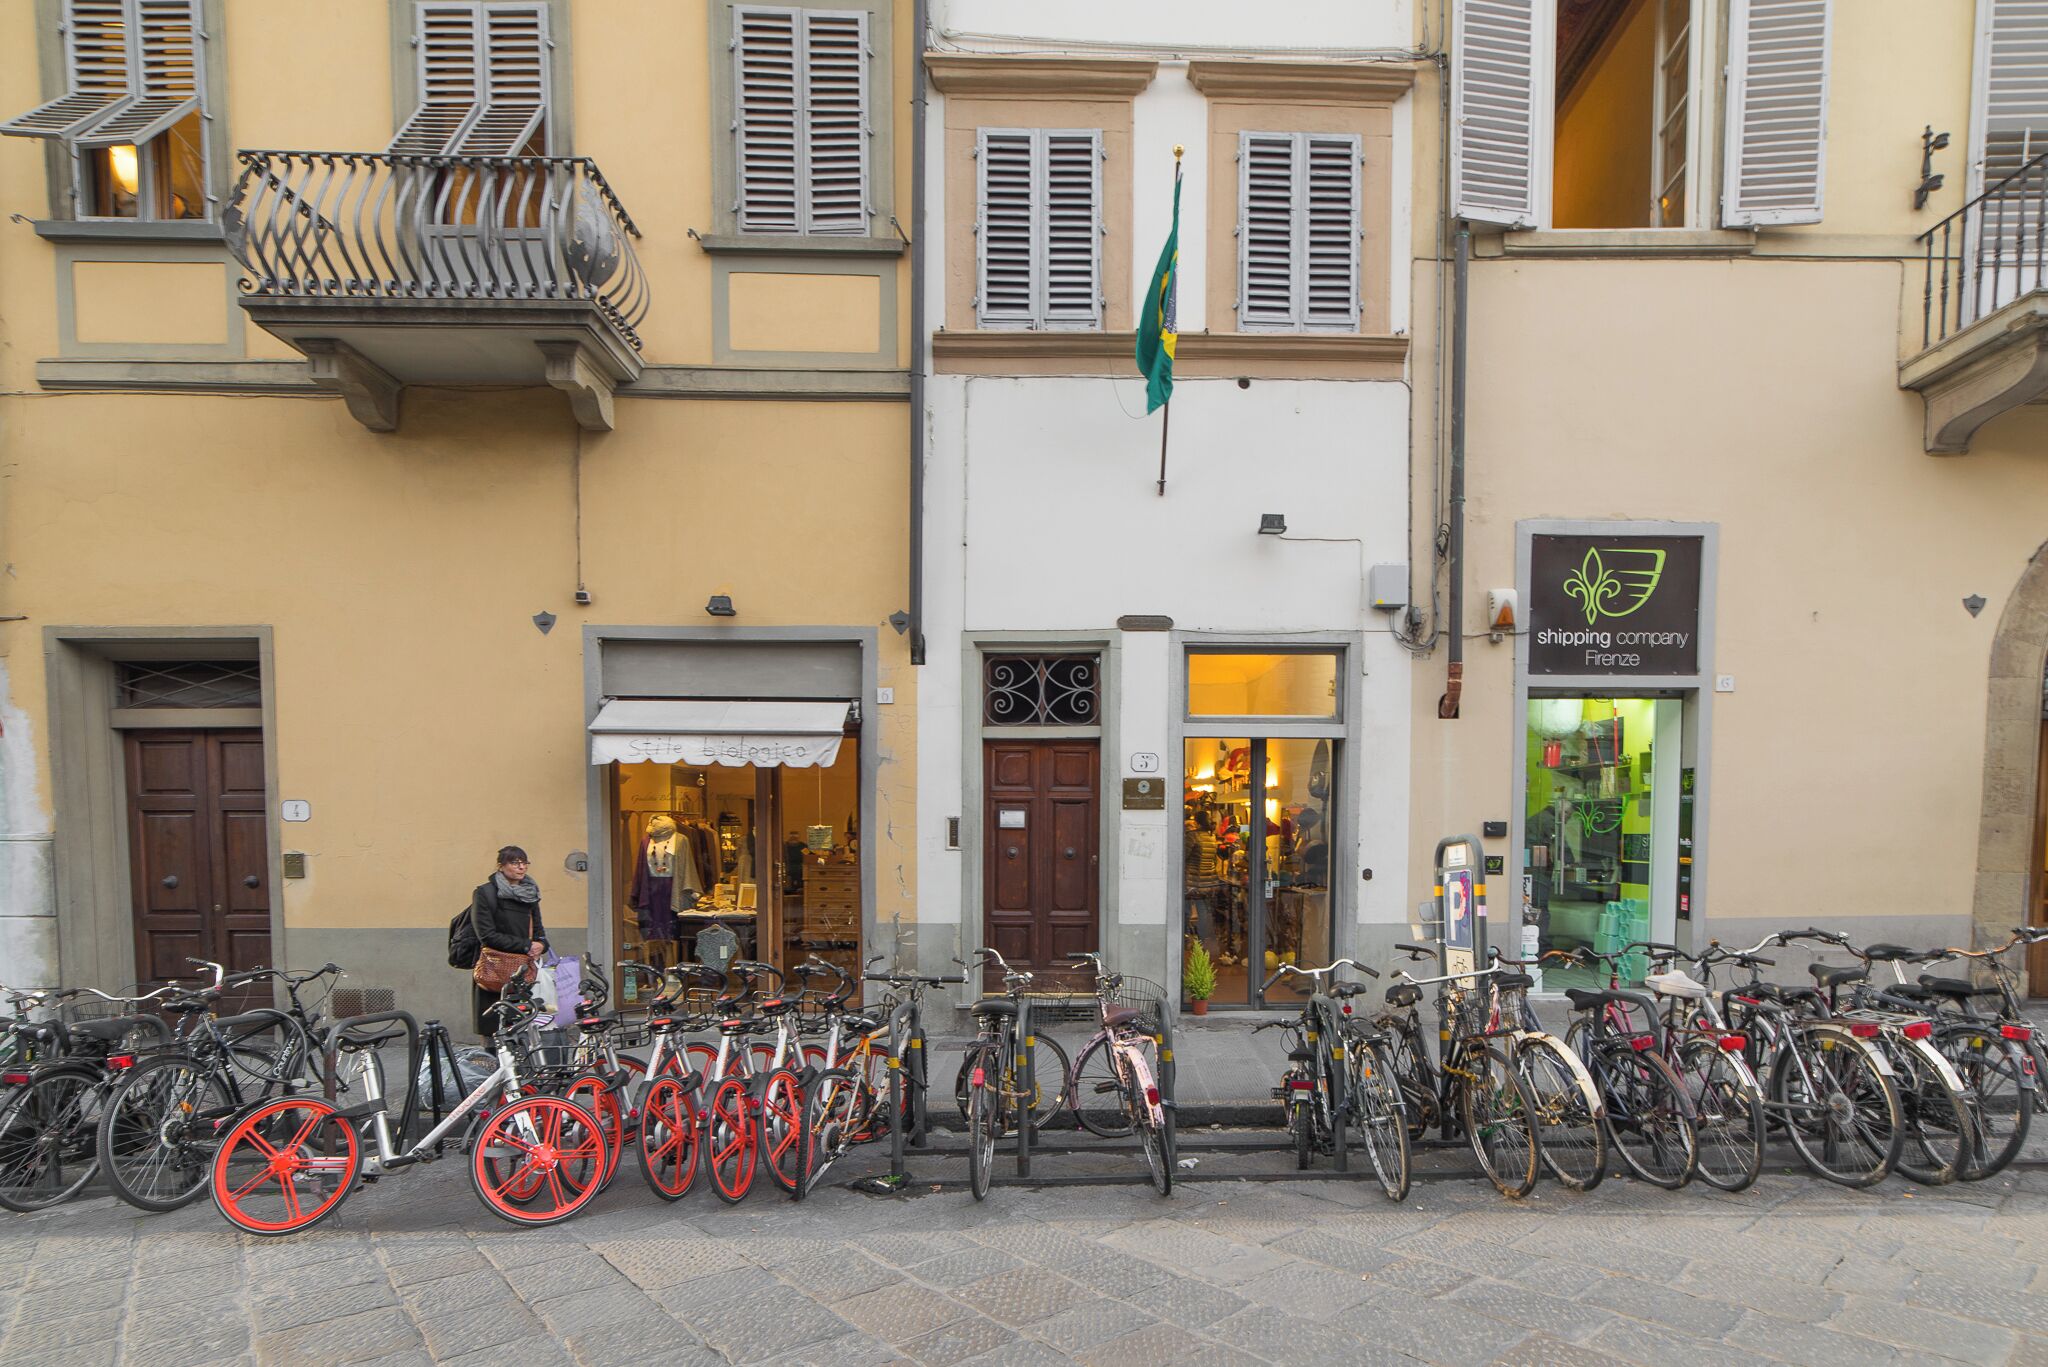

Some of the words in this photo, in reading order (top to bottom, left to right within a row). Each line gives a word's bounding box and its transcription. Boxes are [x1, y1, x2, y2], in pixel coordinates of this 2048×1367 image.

[1537, 628, 1611, 648] shipping
[1616, 631, 1689, 648] company
[1585, 650, 1640, 666] Firenze
[628, 736, 683, 757] Stile
[702, 736, 807, 763] biologico
[1449, 881, 1467, 942] P
